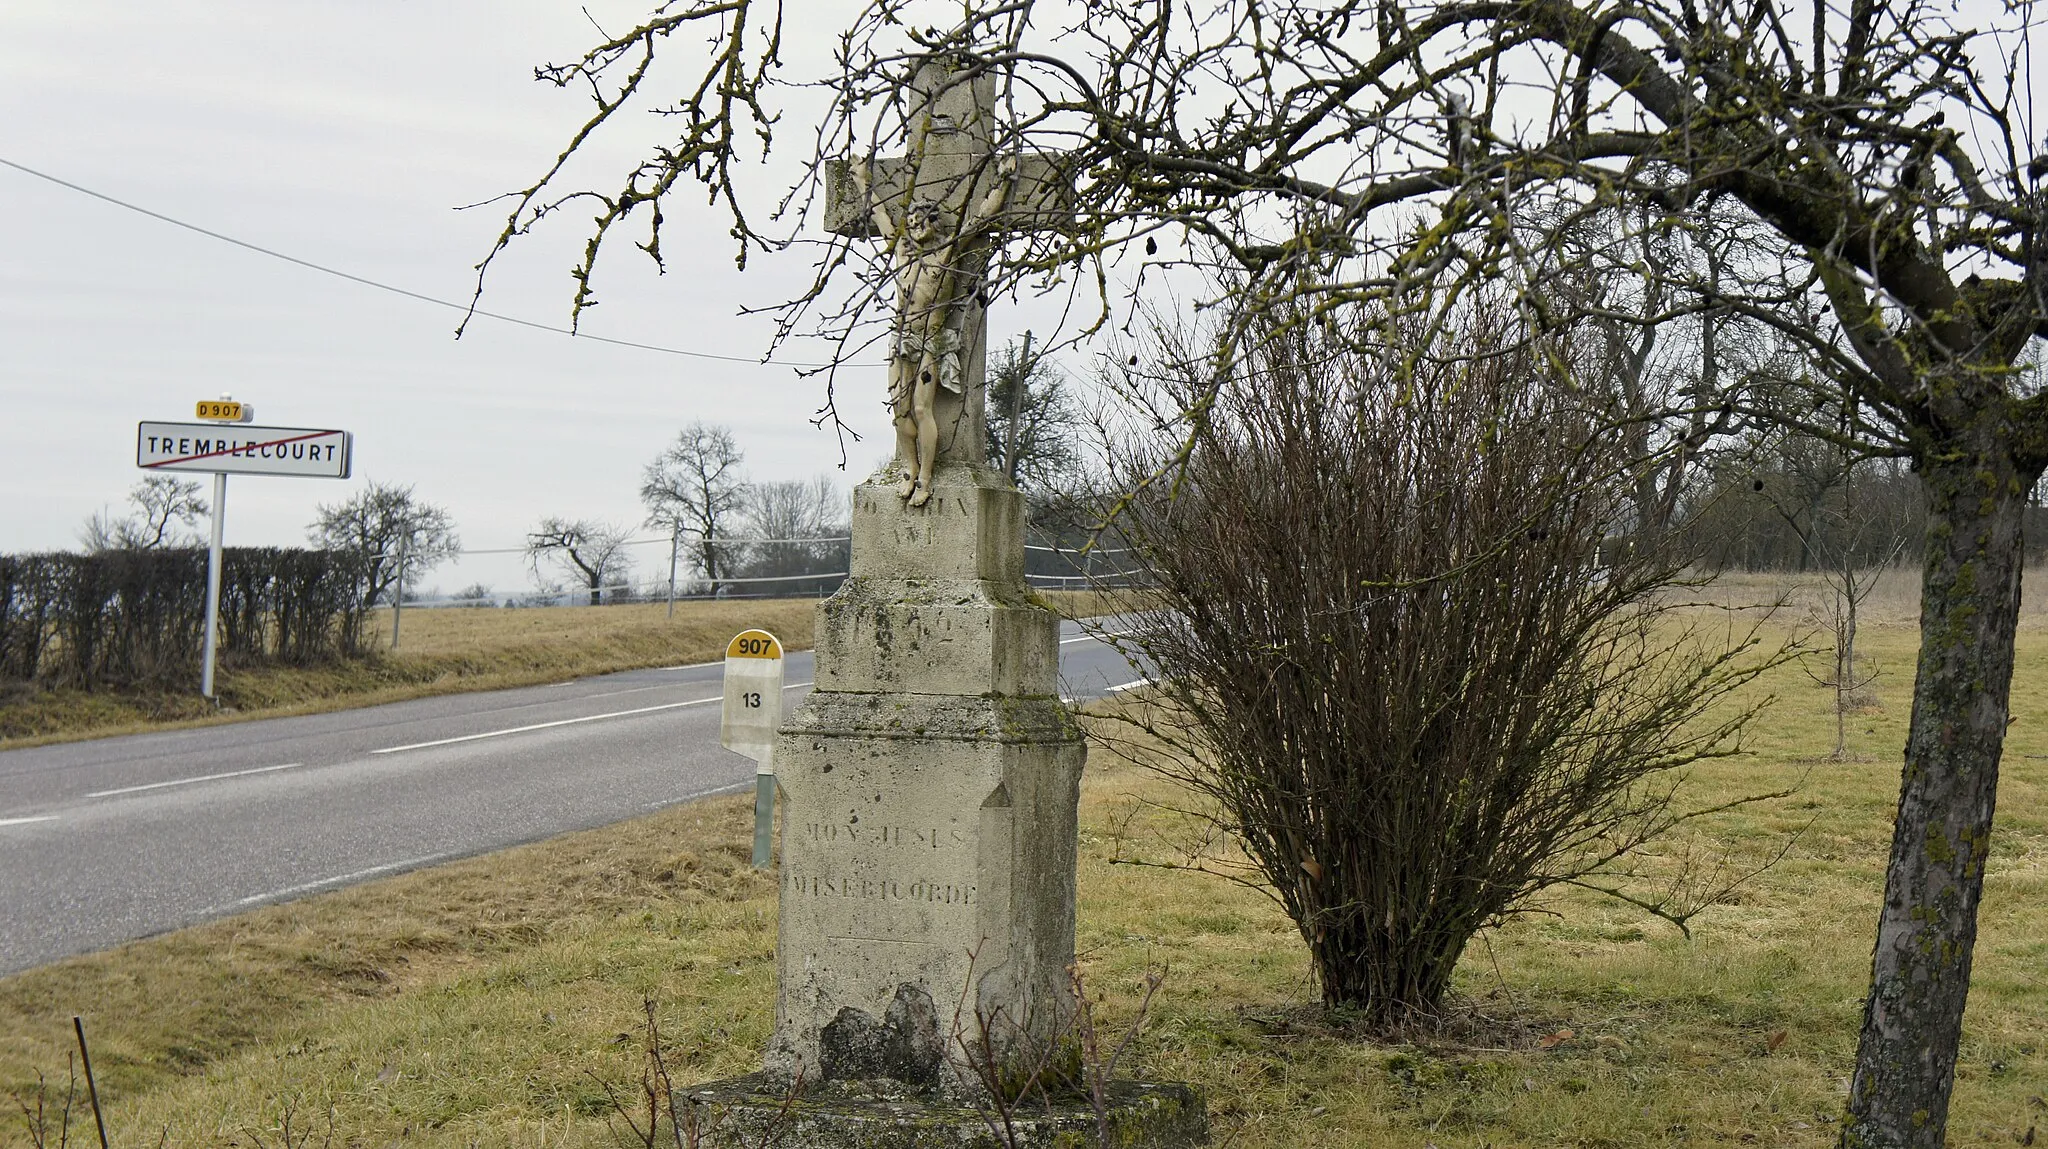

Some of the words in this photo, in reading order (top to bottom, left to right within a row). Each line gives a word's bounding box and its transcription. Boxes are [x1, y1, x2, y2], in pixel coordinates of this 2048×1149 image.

[147, 436, 336, 462] TREMBLECOURT
[738, 638, 772, 655] 907
[742, 692, 761, 708] 13
